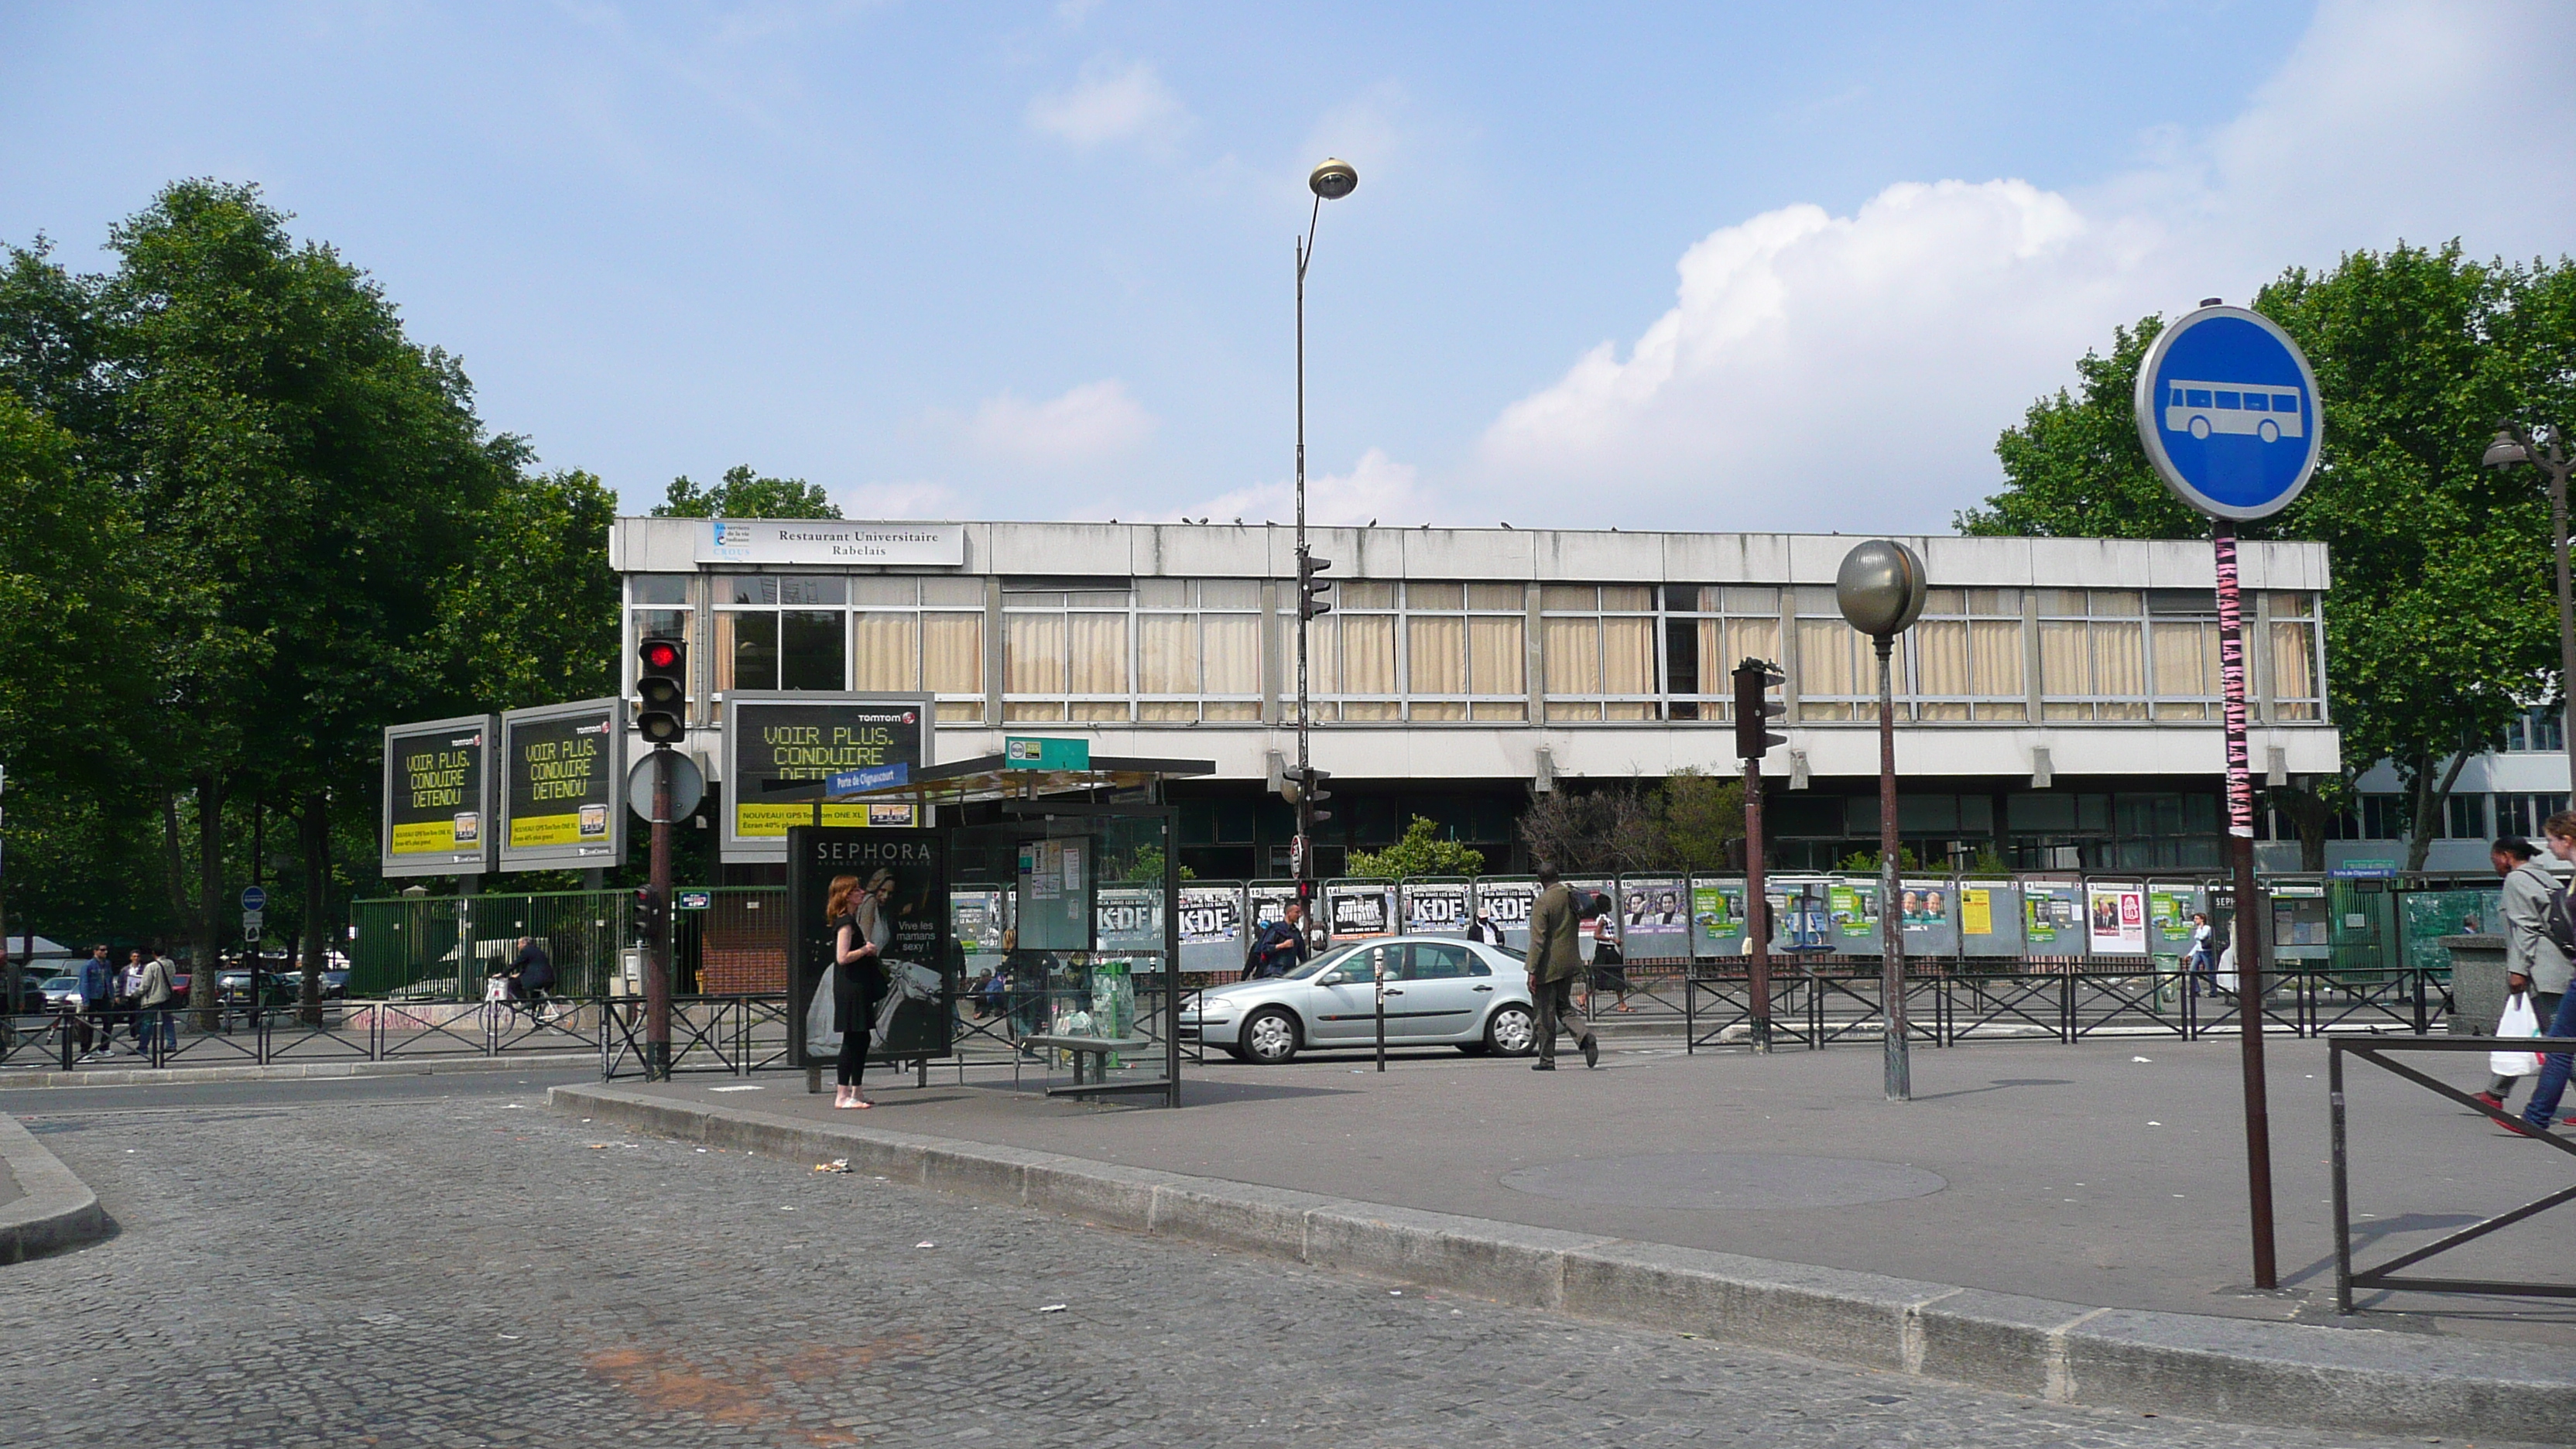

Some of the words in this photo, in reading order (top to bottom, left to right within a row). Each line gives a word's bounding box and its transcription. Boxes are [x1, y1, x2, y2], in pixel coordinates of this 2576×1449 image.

[779, 530, 849, 542] Restaurant
[855, 532, 939, 543] Universitaire
[832, 546, 886, 556] Rabelais
[2222, 640, 2242, 660] LA
[764, 727, 820, 745] VOIR
[834, 727, 893, 745] PLUS.
[526, 742, 556, 762] VOIR
[562, 738, 597, 759] PLUS.
[774, 748, 884, 765] CONDUIRE
[2228, 741, 2248, 762] LA
[406, 754, 433, 772] VOIR
[439, 750, 470, 769] PLUS.
[530, 759, 591, 780] CONDUIRE
[411, 769, 465, 790] CONDUIRE
[837, 776, 851, 788] Porte
[852, 775, 859, 786] de
[860, 769, 894, 786] Clignancourt
[413, 788, 461, 808] DETENDU
[533, 779, 587, 800] DETENDU
[2229, 768, 2252, 827] RAFAL
[817, 842, 930, 859] SEPHORA
[2215, 897, 2236, 906] SEPH
[898, 921, 918, 930] Vive
[920, 920, 933, 930] les
[896, 933, 936, 941] mamans
[903, 943, 924, 953] sexy
